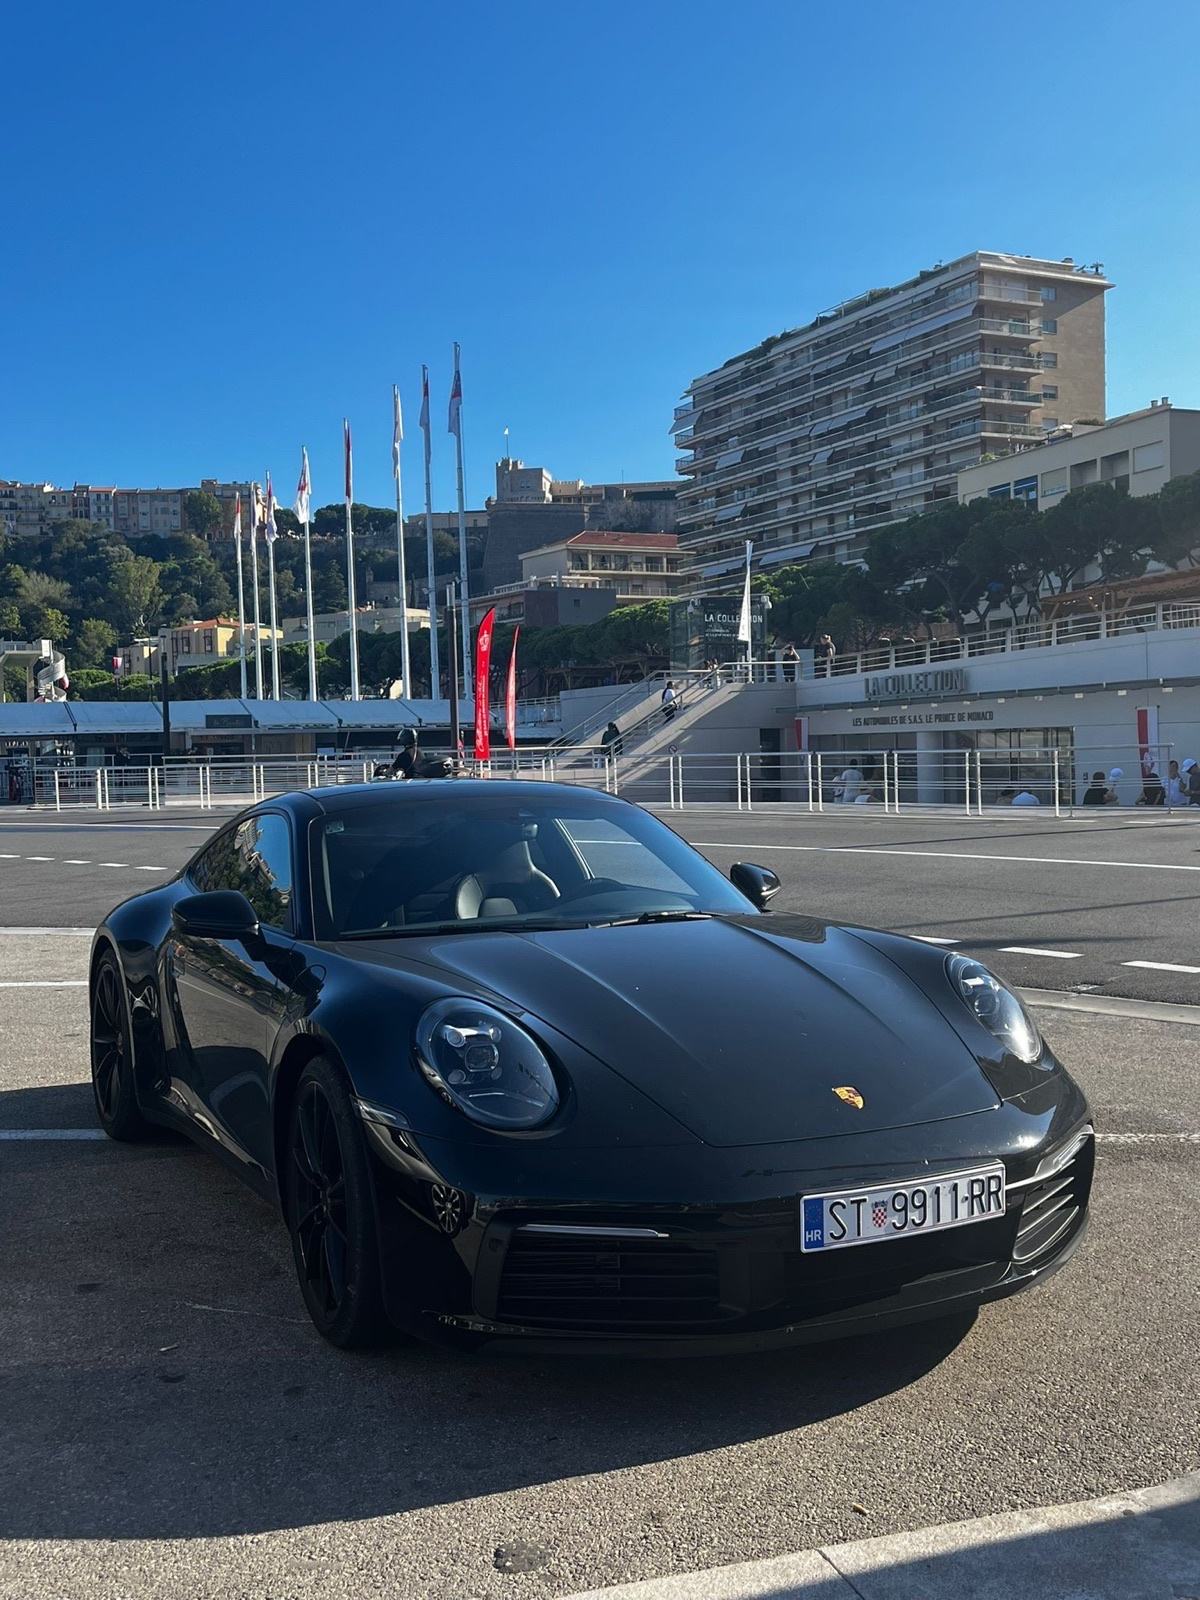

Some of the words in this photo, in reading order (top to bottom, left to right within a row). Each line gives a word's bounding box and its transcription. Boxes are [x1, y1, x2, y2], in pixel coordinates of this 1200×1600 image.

[704, 613, 714, 622] LA
[717, 614, 763, 623] COLLEON
[864, 677, 881, 697] LA
[883, 669, 967, 696] COLLECTION
[852, 718, 862, 726] LES
[899, 715, 908, 725] DE
[926, 714, 933, 724] LE
[934, 713, 956, 723] PRINCE
[957, 712, 966, 722] DE
[967, 711, 994, 722] MONACO
[829, 1197, 868, 1241] ST
[805, 1229, 822, 1243] HR
